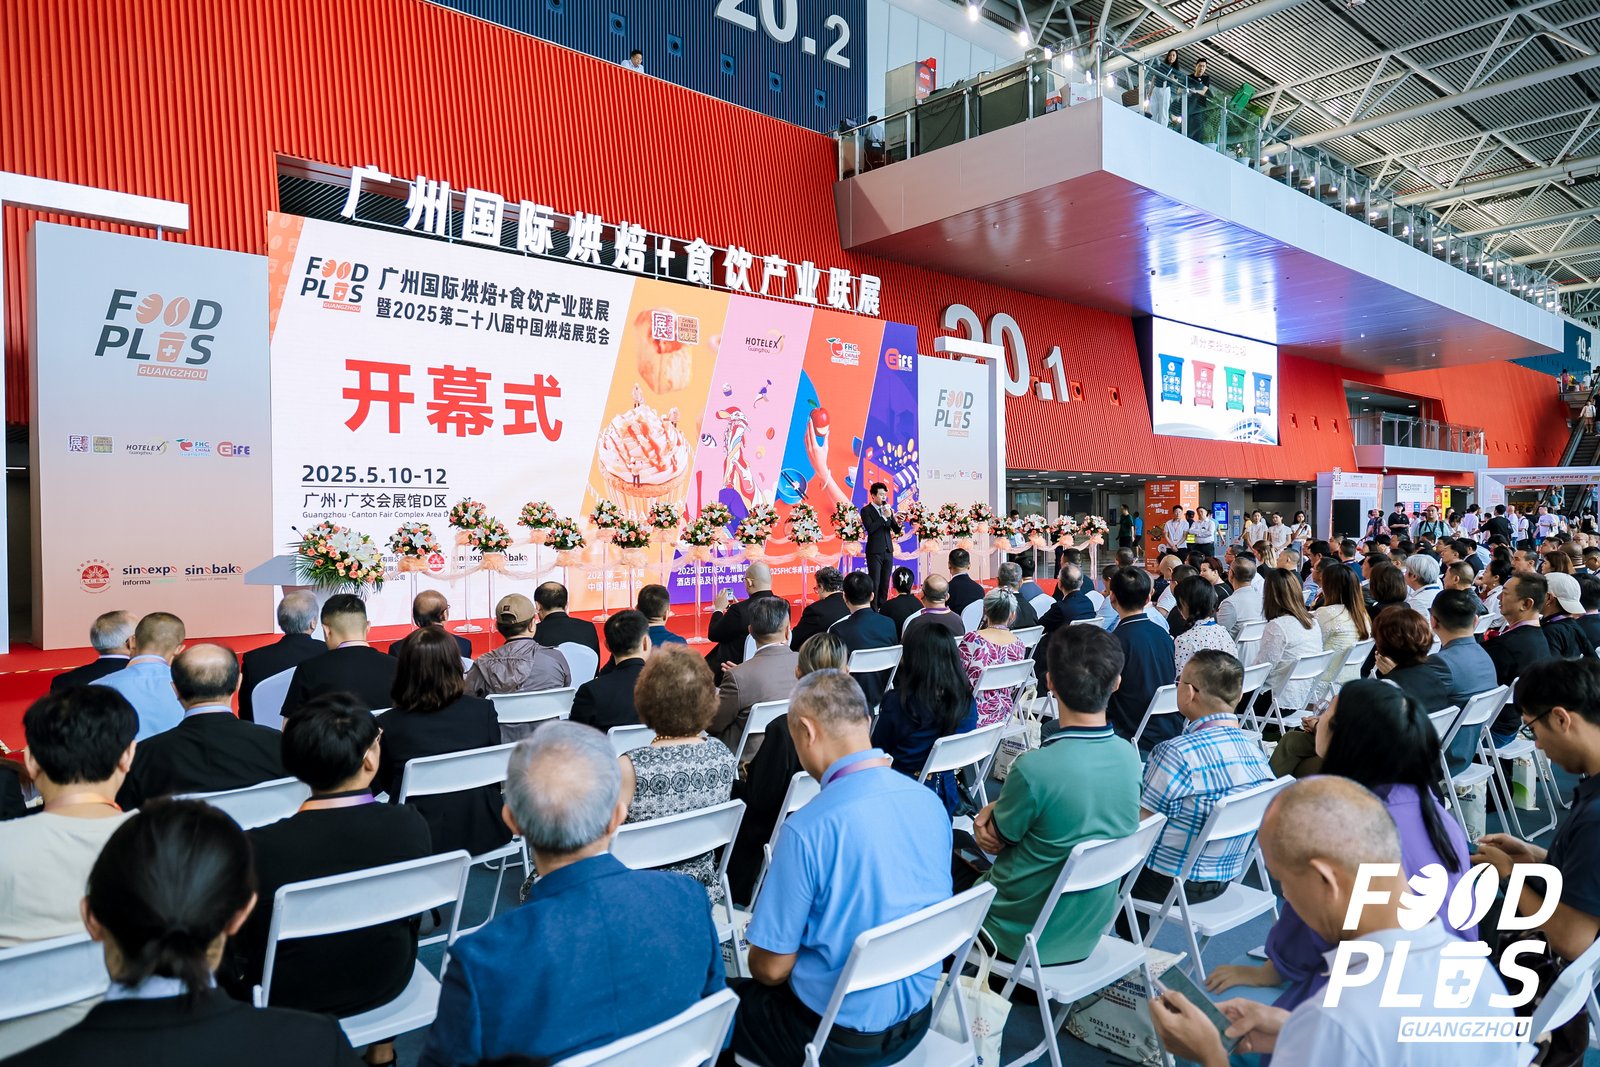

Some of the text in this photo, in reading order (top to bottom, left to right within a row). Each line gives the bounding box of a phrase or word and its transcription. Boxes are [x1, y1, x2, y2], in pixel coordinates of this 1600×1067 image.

[341, 165, 881, 316] 广州国际烘焙+食饮产业联展
[378, 267, 610, 322] 广州国际烘焙+食饮产业联展
[323, 302, 361, 312] GUANGZHOU
[376, 297, 610, 345] 暨2025第二十八届中国烘焙展览会
[745, 335, 783, 349] HOTELEX
[138, 366, 208, 379] GUANGZHOU
[342, 359, 563, 442] 开幕式
[126, 441, 166, 452] HOTELEX
[302, 465, 447, 484] 2025.5.10-12
[303, 492, 447, 508] 广州·广交会展馆D区
[302, 511, 347, 519] Guangzhou
[395, 511, 424, 520] Complex
